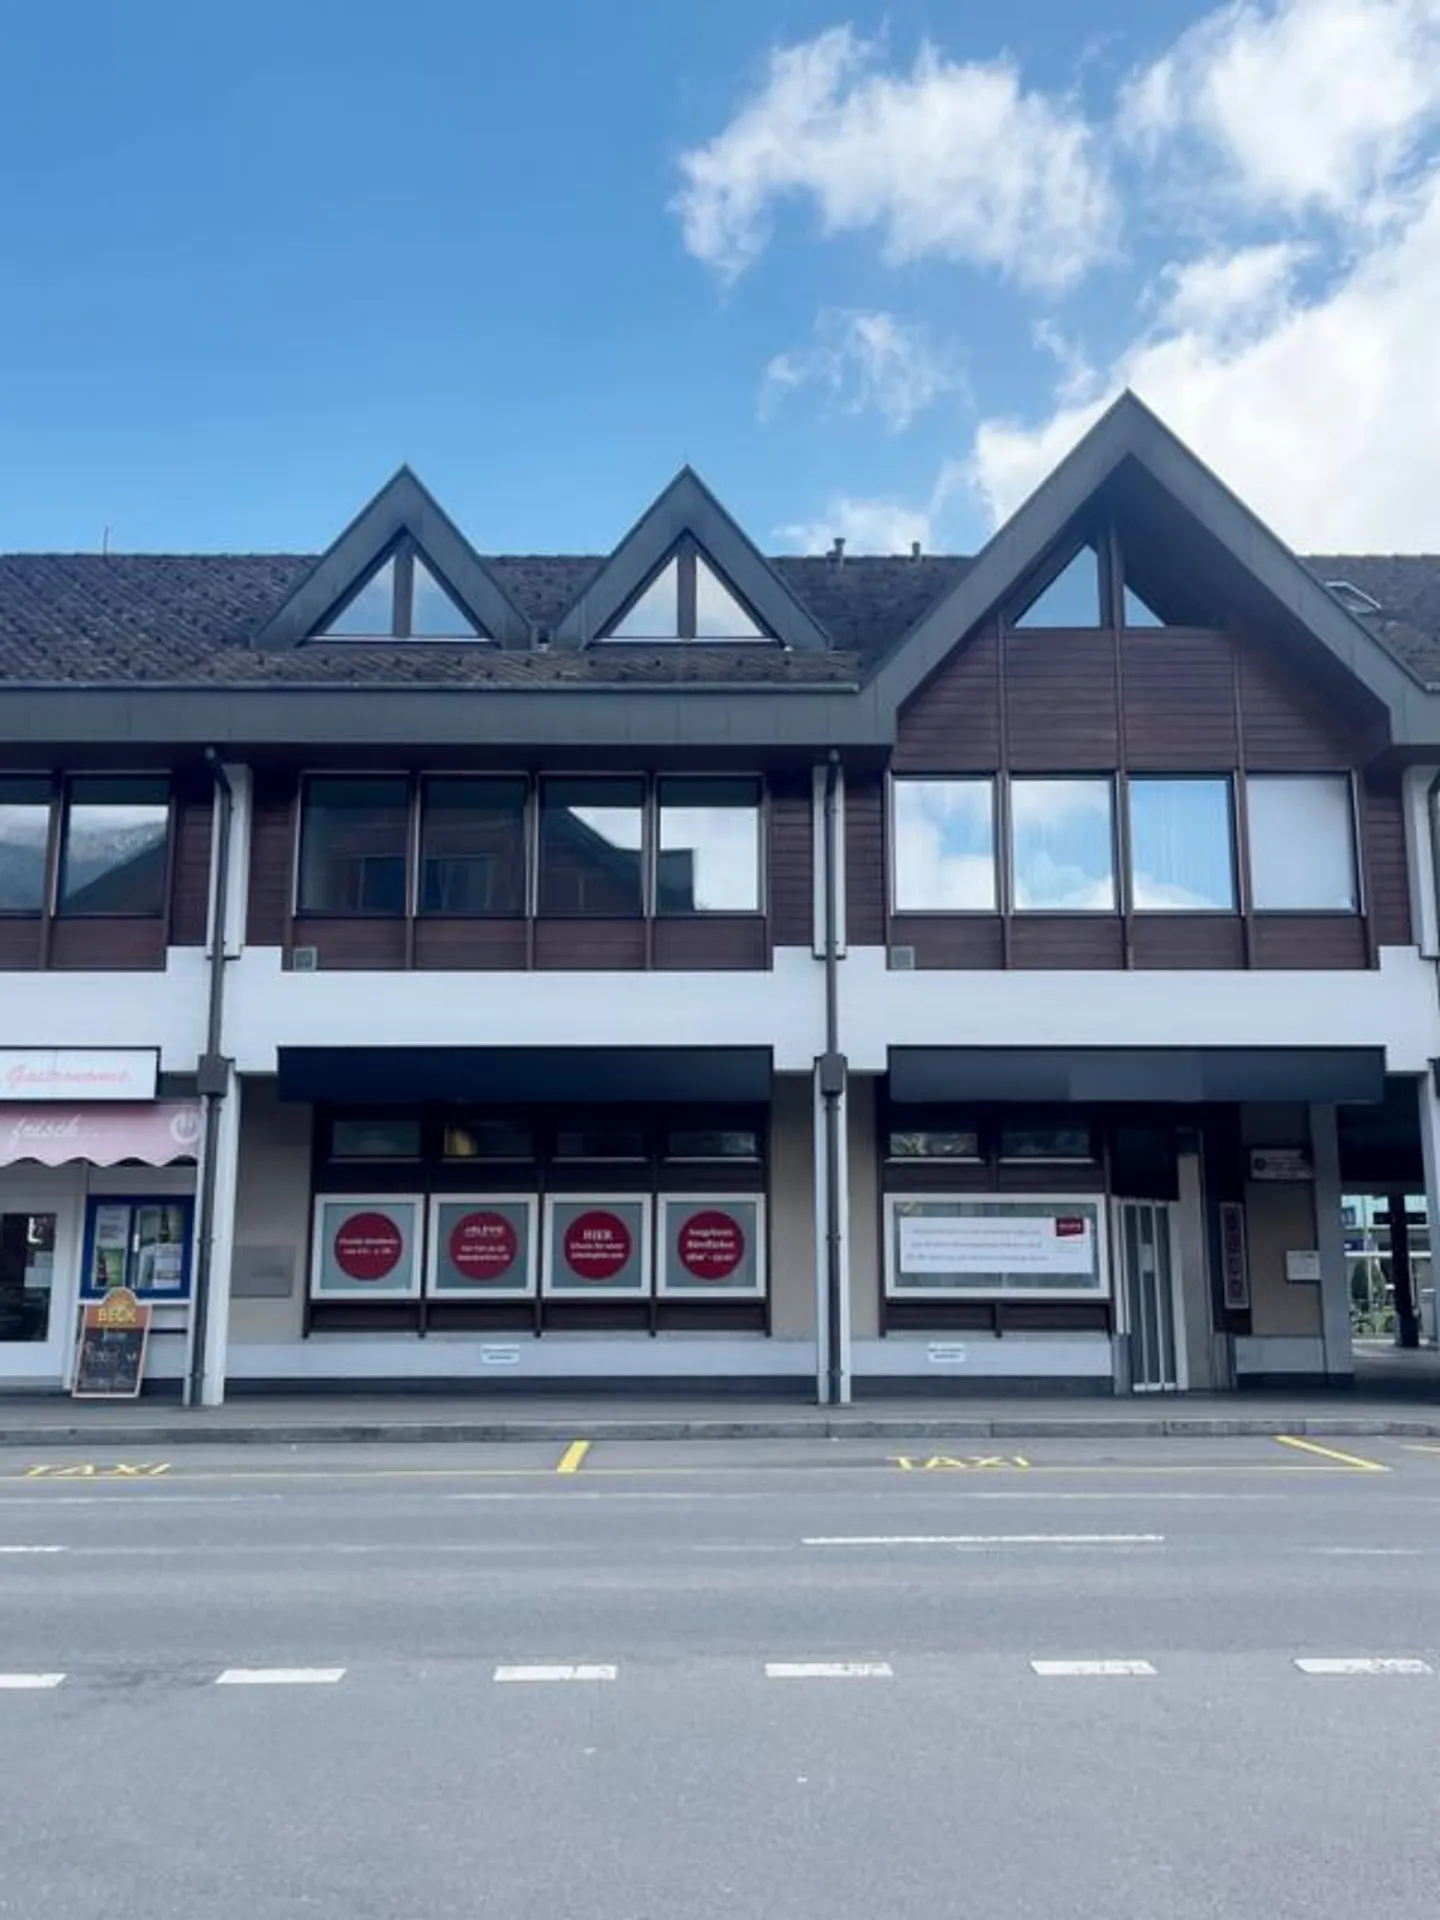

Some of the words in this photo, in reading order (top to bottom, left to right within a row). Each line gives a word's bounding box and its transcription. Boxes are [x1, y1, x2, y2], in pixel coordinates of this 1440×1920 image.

[583, 1228, 613, 1241] HIER
[885, 1457, 1030, 1470] TAXI
[25, 1464, 172, 1477] TAXI
